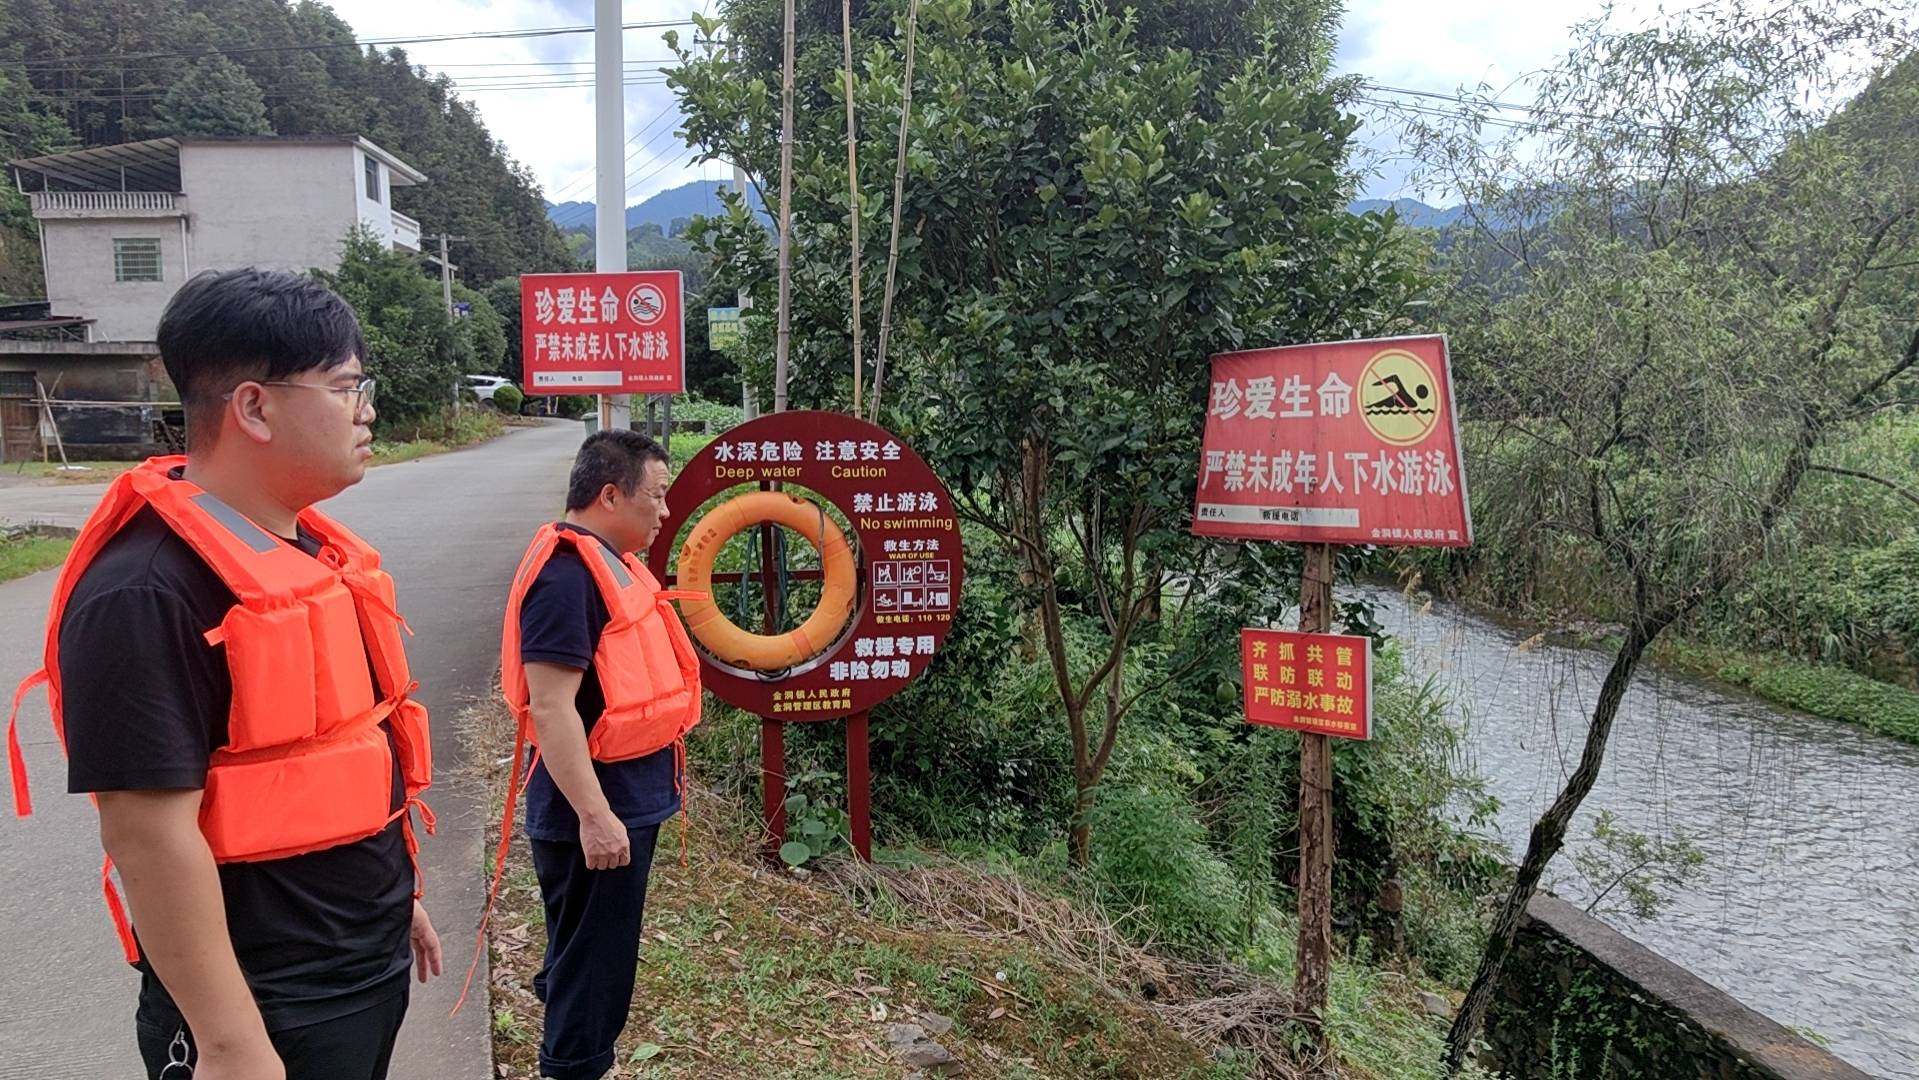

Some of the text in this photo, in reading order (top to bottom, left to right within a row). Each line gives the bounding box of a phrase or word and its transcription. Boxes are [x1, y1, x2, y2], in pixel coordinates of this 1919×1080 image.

[534, 286, 620, 325] 珍爱生命
[534, 331, 669, 361] 严禁未成年人下水游泳
[1211, 372, 1353, 420] 珍爱生命
[714, 440, 902, 462] 水深危险 注意安全
[715, 465, 887, 479] Deep water Caution
[1201, 449, 1455, 496] 严禁未成年人下水游泳
[853, 492, 938, 513] 禁止游泳
[1201, 507, 1226, 518] 责任人
[861, 517, 953, 531] No swimming
[1262, 510, 1299, 521] 救援电话
[1371, 528, 1444, 540] 金洞镇人民政府
[884, 539, 939, 552] 救生方法
[854, 635, 935, 657] 救援专用
[1252, 640, 1352, 666] 齐抓共管
[830, 660, 910, 681] 非险勿动
[1252, 663, 1352, 690] 联防联动
[773, 688, 851, 700] 金洞镇人民政府
[1254, 686, 1353, 715] 严防溺水事故
[773, 699, 851, 712] 金洞管理区教育局
